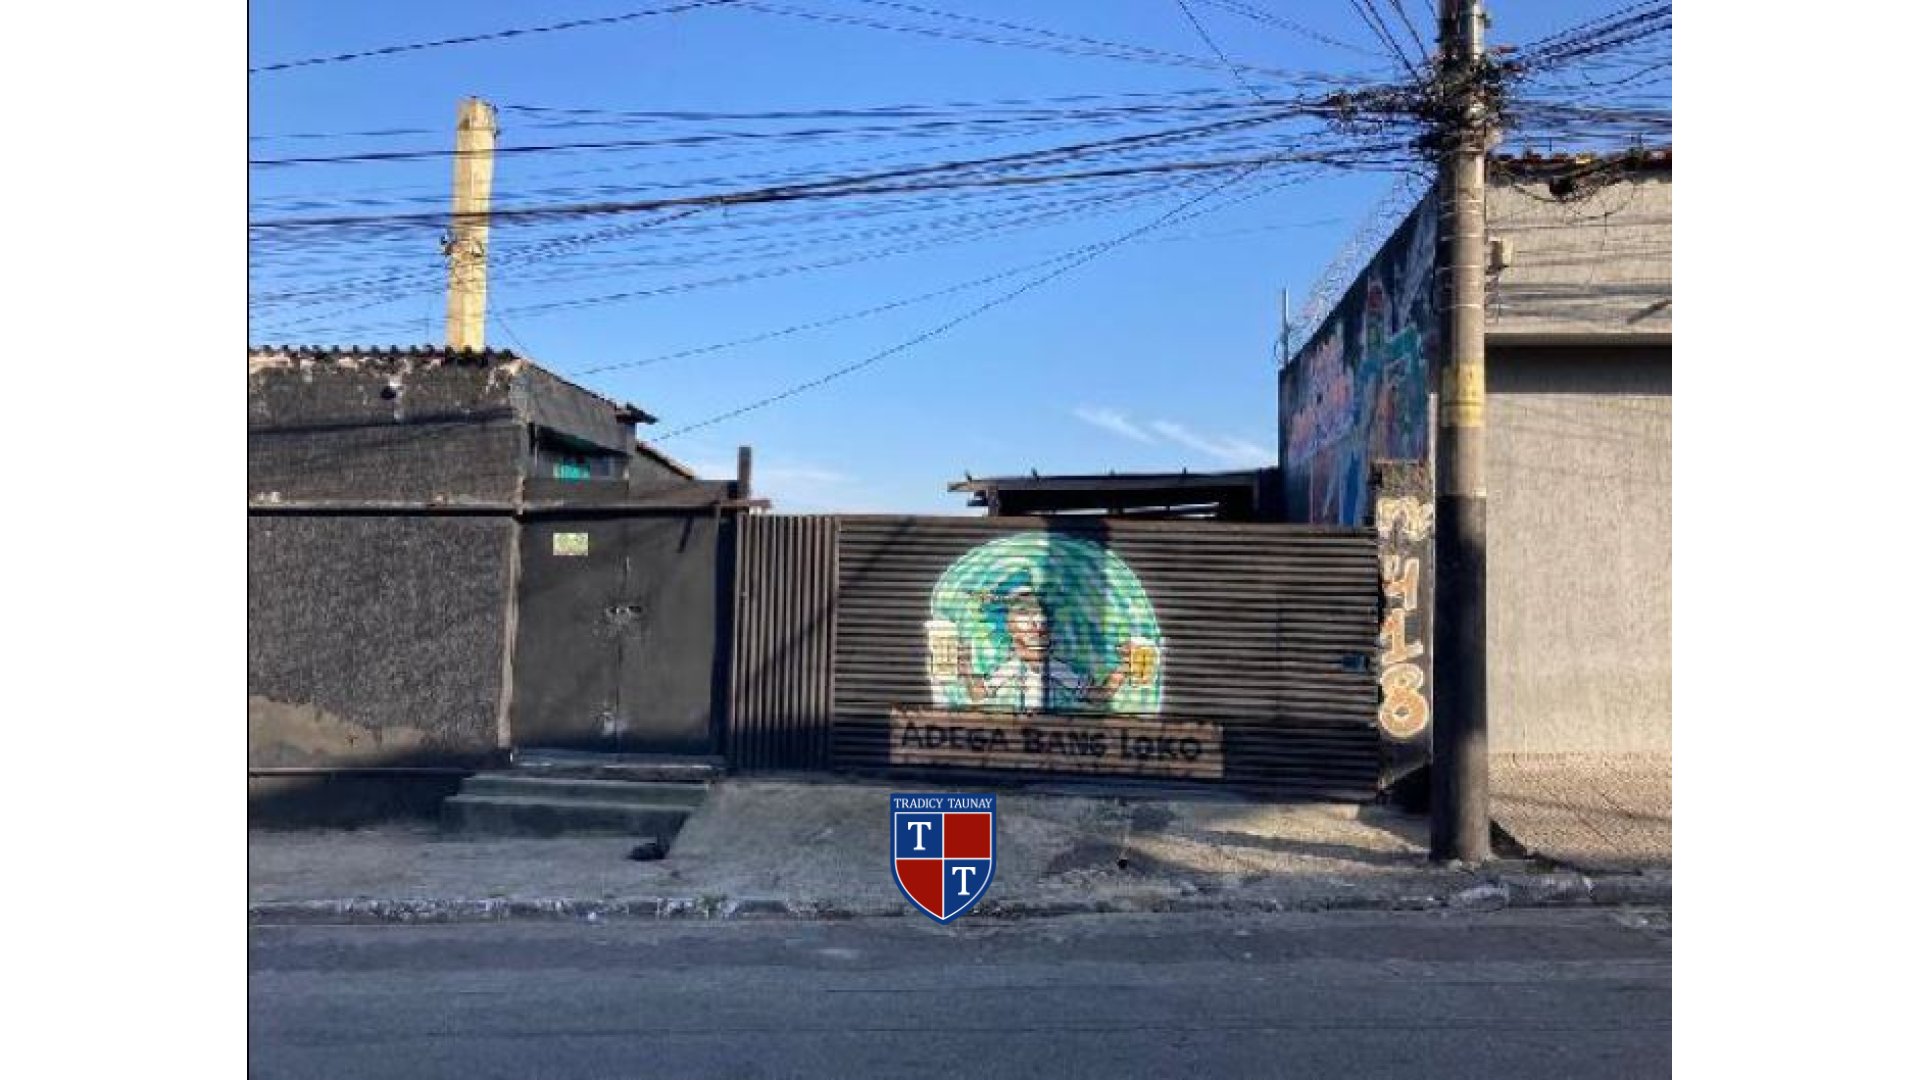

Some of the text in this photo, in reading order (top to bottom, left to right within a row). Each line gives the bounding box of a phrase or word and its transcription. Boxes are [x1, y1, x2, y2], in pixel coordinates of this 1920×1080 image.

[1379, 554, 1428, 738] 418
[901, 722, 1007, 752] ADEGA
[1022, 727, 1106, 757] BANG
